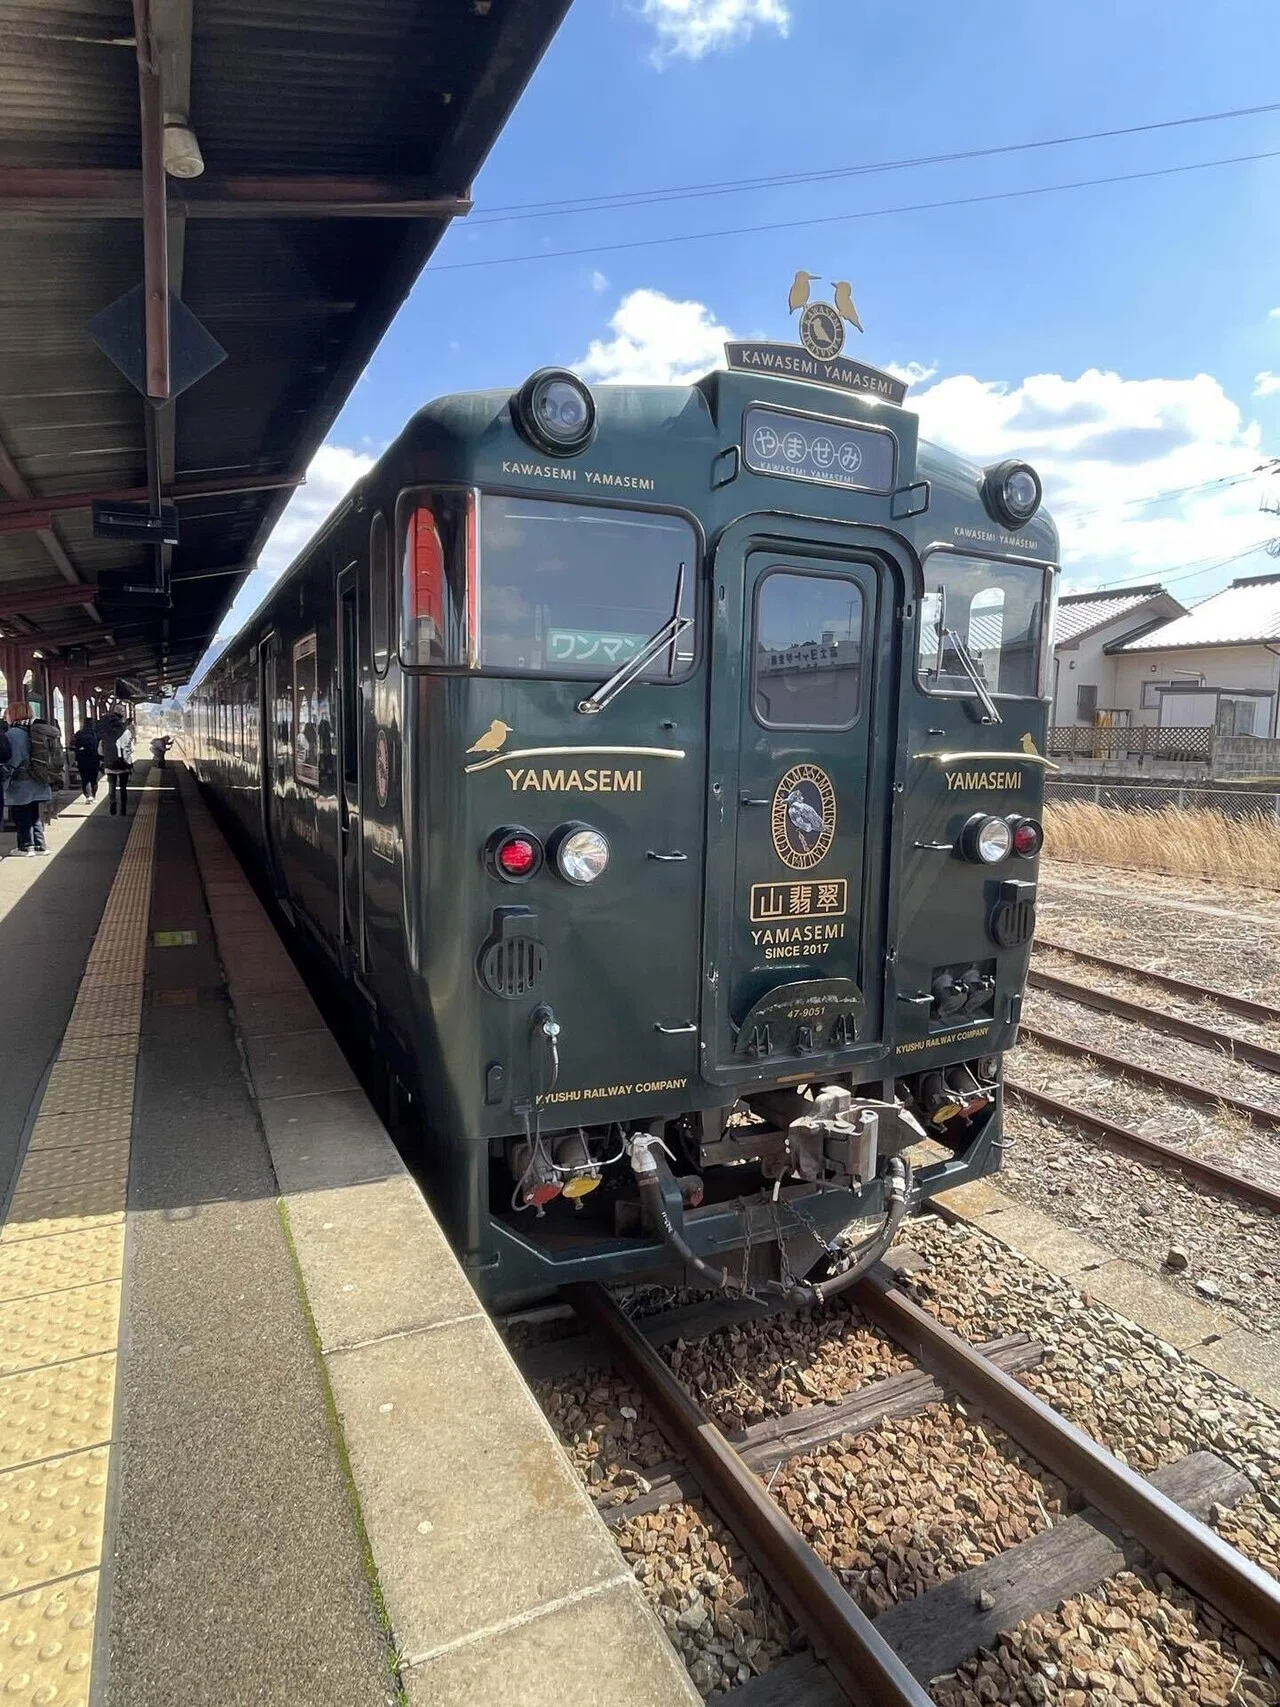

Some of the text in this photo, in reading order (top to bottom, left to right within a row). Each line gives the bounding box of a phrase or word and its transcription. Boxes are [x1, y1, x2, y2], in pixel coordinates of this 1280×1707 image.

[742, 350, 893, 395] KAWASEMI YAMASEMI
[755, 429, 860, 470] やませみ
[502, 461, 655, 490] KAWASEMI YAMASEMI
[760, 462, 854, 484] KAWASEMI YAMASEMI
[954, 527, 1038, 549] KAWASEMI YAMASEMI
[505, 768, 642, 792] YAMASEMI
[945, 771, 1022, 790] YAMASEMI
[760, 884, 839, 917] 山翡翠
[751, 923, 845, 946] YAMASEMI
[765, 943, 829, 959] SINCE 2017
[787, 1007, 826, 1019] 47-9051
[895, 1027, 990, 1055] KYUSHU RAILWAY COMPANY
[583, 1084, 633, 1100] RAILWAY
[635, 1078, 688, 1094] COMPANY
